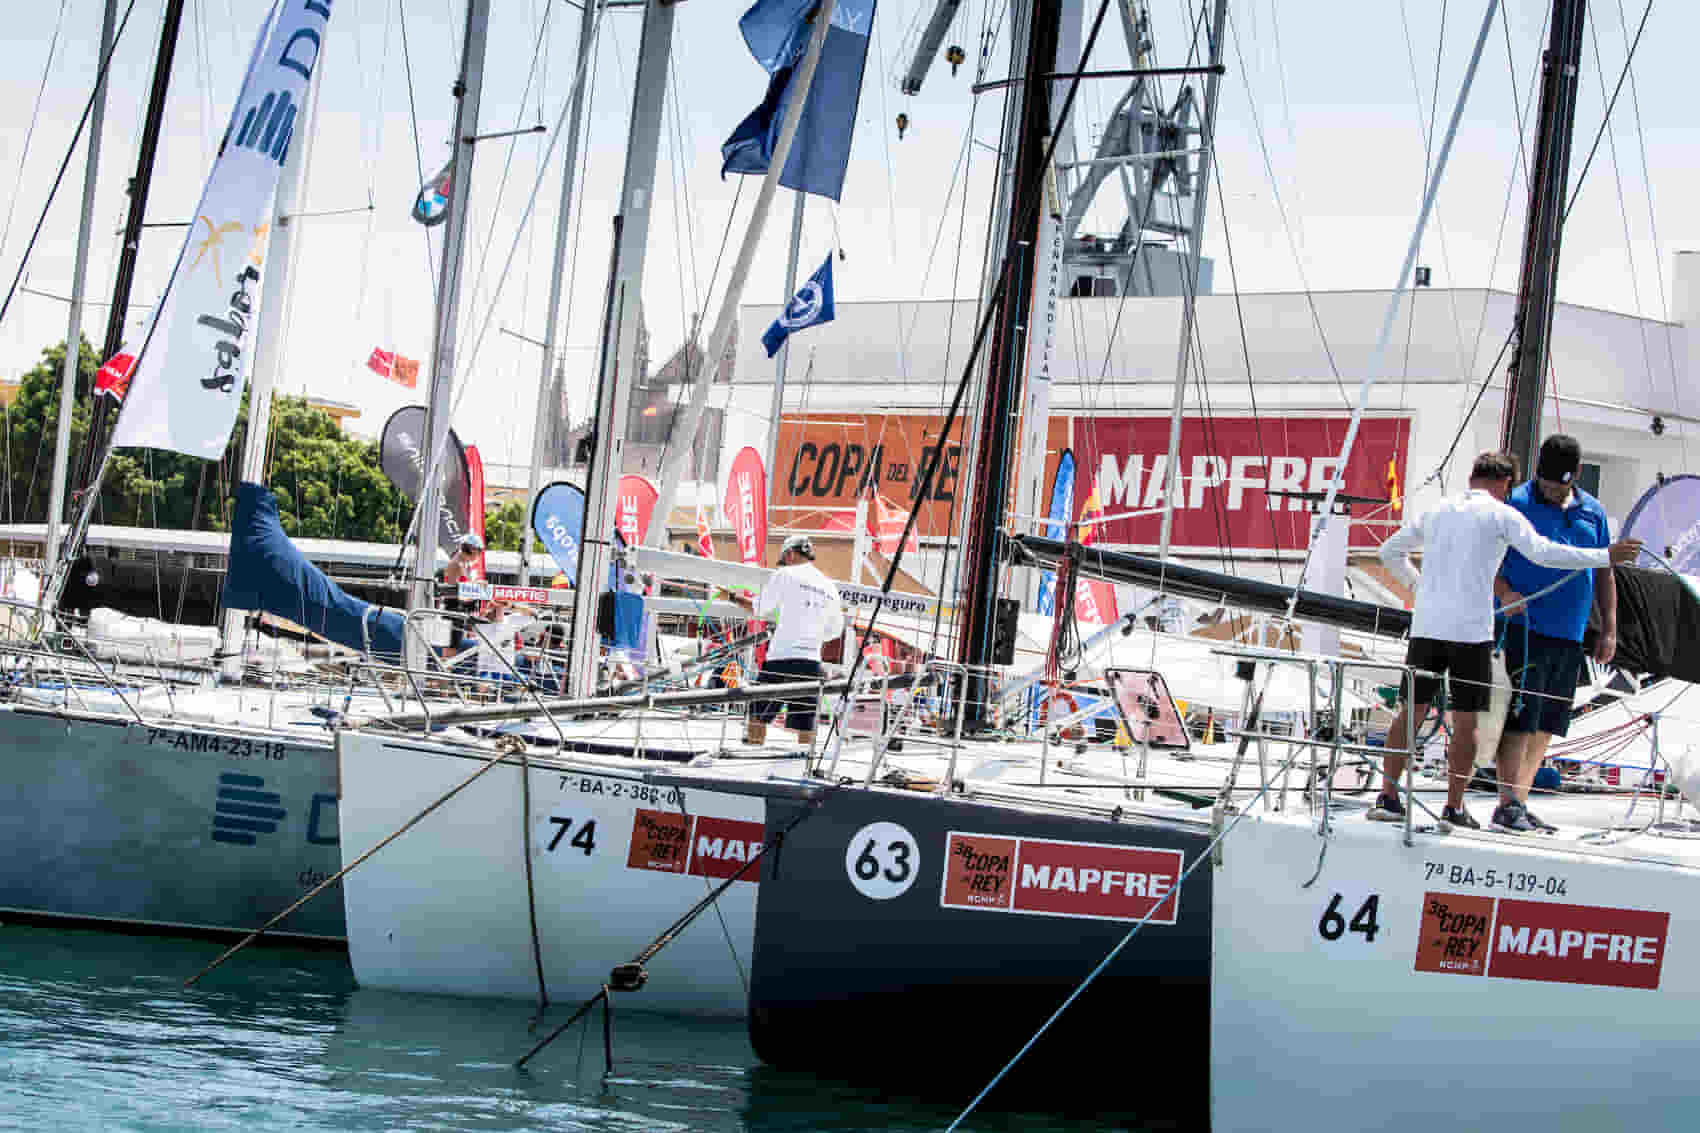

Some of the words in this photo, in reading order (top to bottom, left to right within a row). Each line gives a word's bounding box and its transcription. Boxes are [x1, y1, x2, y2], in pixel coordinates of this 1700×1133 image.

[788, 441, 886, 499] COPA
[887, 462, 907, 482] DEL
[1097, 454, 1346, 512] MAPFRE
[546, 816, 597, 857] 74
[855, 839, 911, 883] 63
[964, 853, 1009, 872] COPA
[969, 872, 1006, 893] REY
[1020, 863, 1172, 898] MAPFRE
[1449, 864, 1568, 897] BA-5-139-04
[1318, 892, 1381, 943] 64
[1440, 911, 1487, 936] COPA
[1443, 935, 1482, 960] REY
[1497, 924, 1658, 965] MAPFRE
